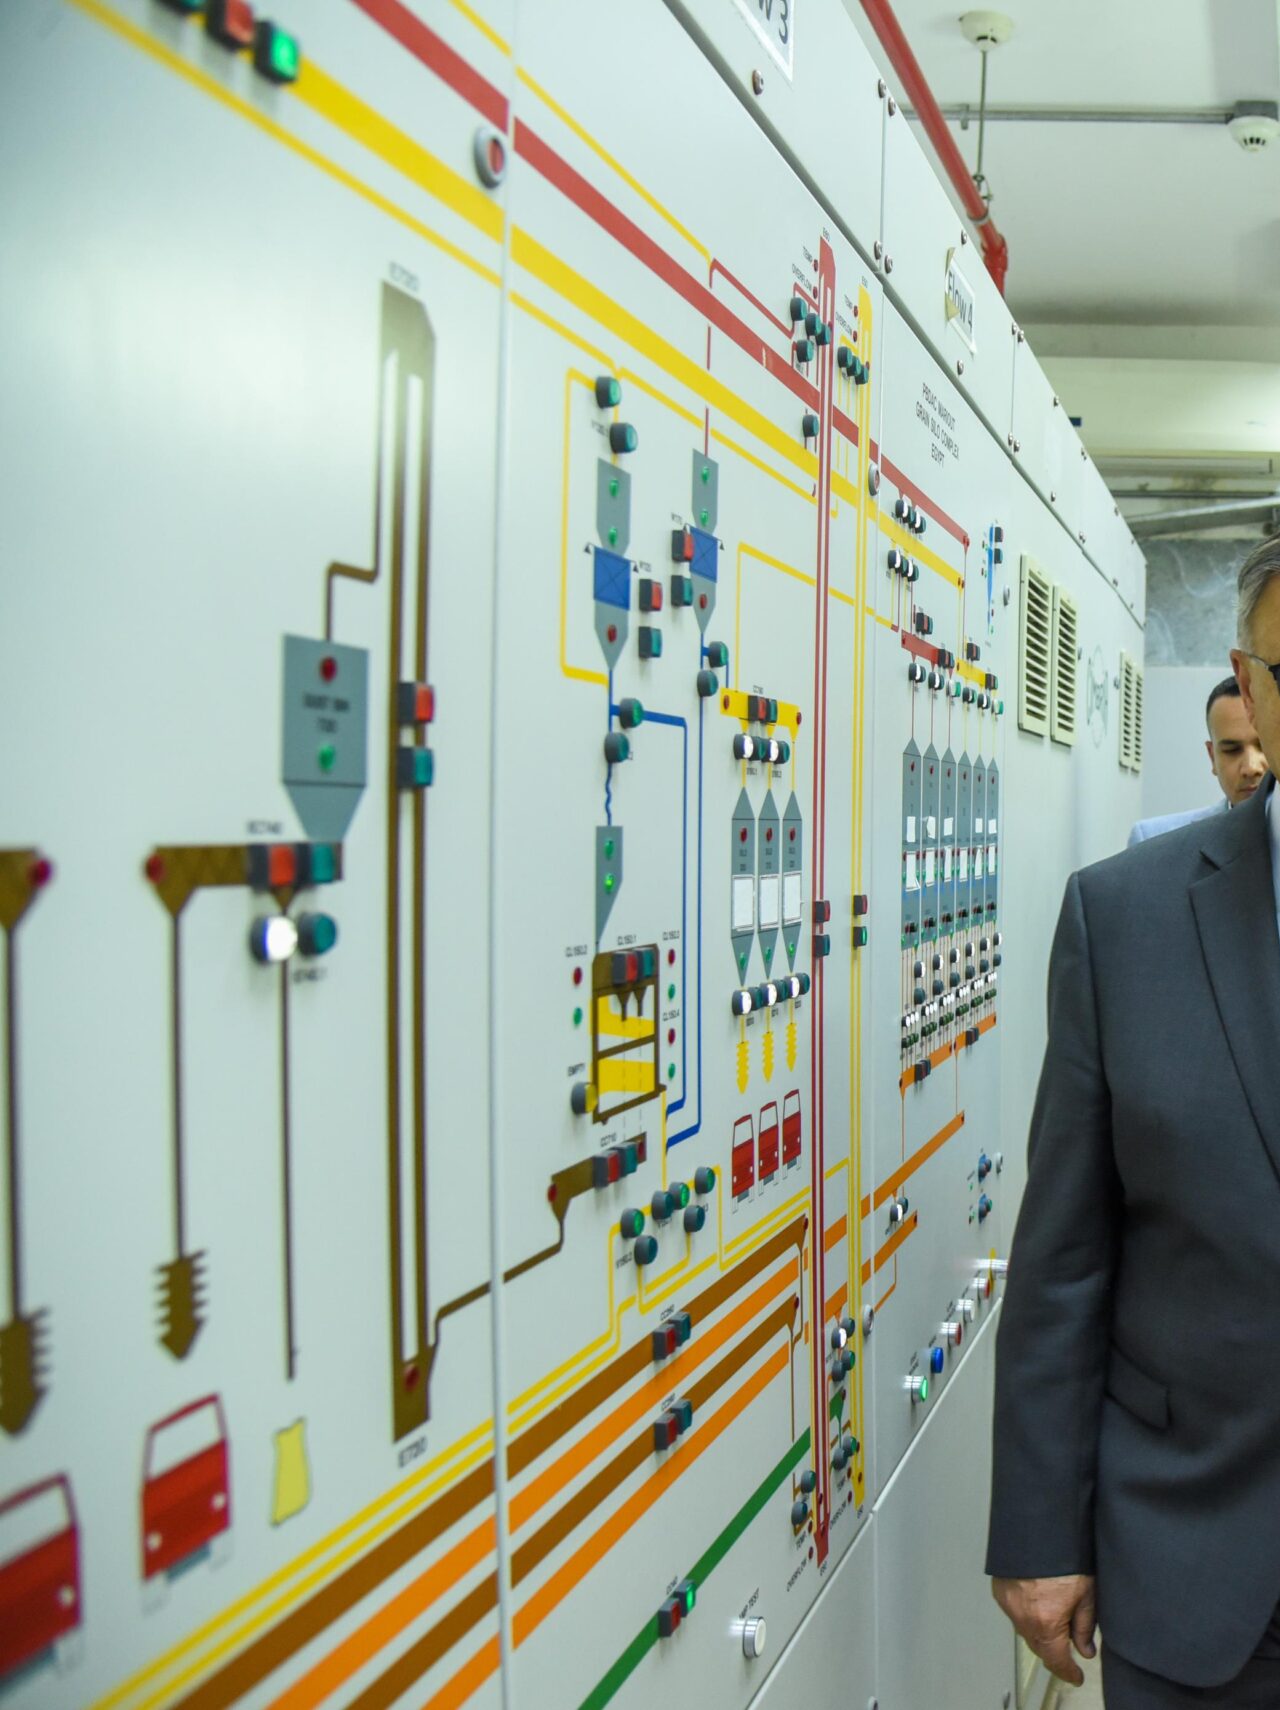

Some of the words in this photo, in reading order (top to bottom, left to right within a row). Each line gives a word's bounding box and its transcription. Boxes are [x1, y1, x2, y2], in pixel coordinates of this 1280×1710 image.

[948, 269, 967, 324] Flow
[922, 382, 938, 412] PBDAC
[916, 400, 930, 429] GRAIN
[930, 417, 941, 440] SILO
[940, 429, 960, 461] COMPLEX
[931, 442, 945, 469] EGYPT
